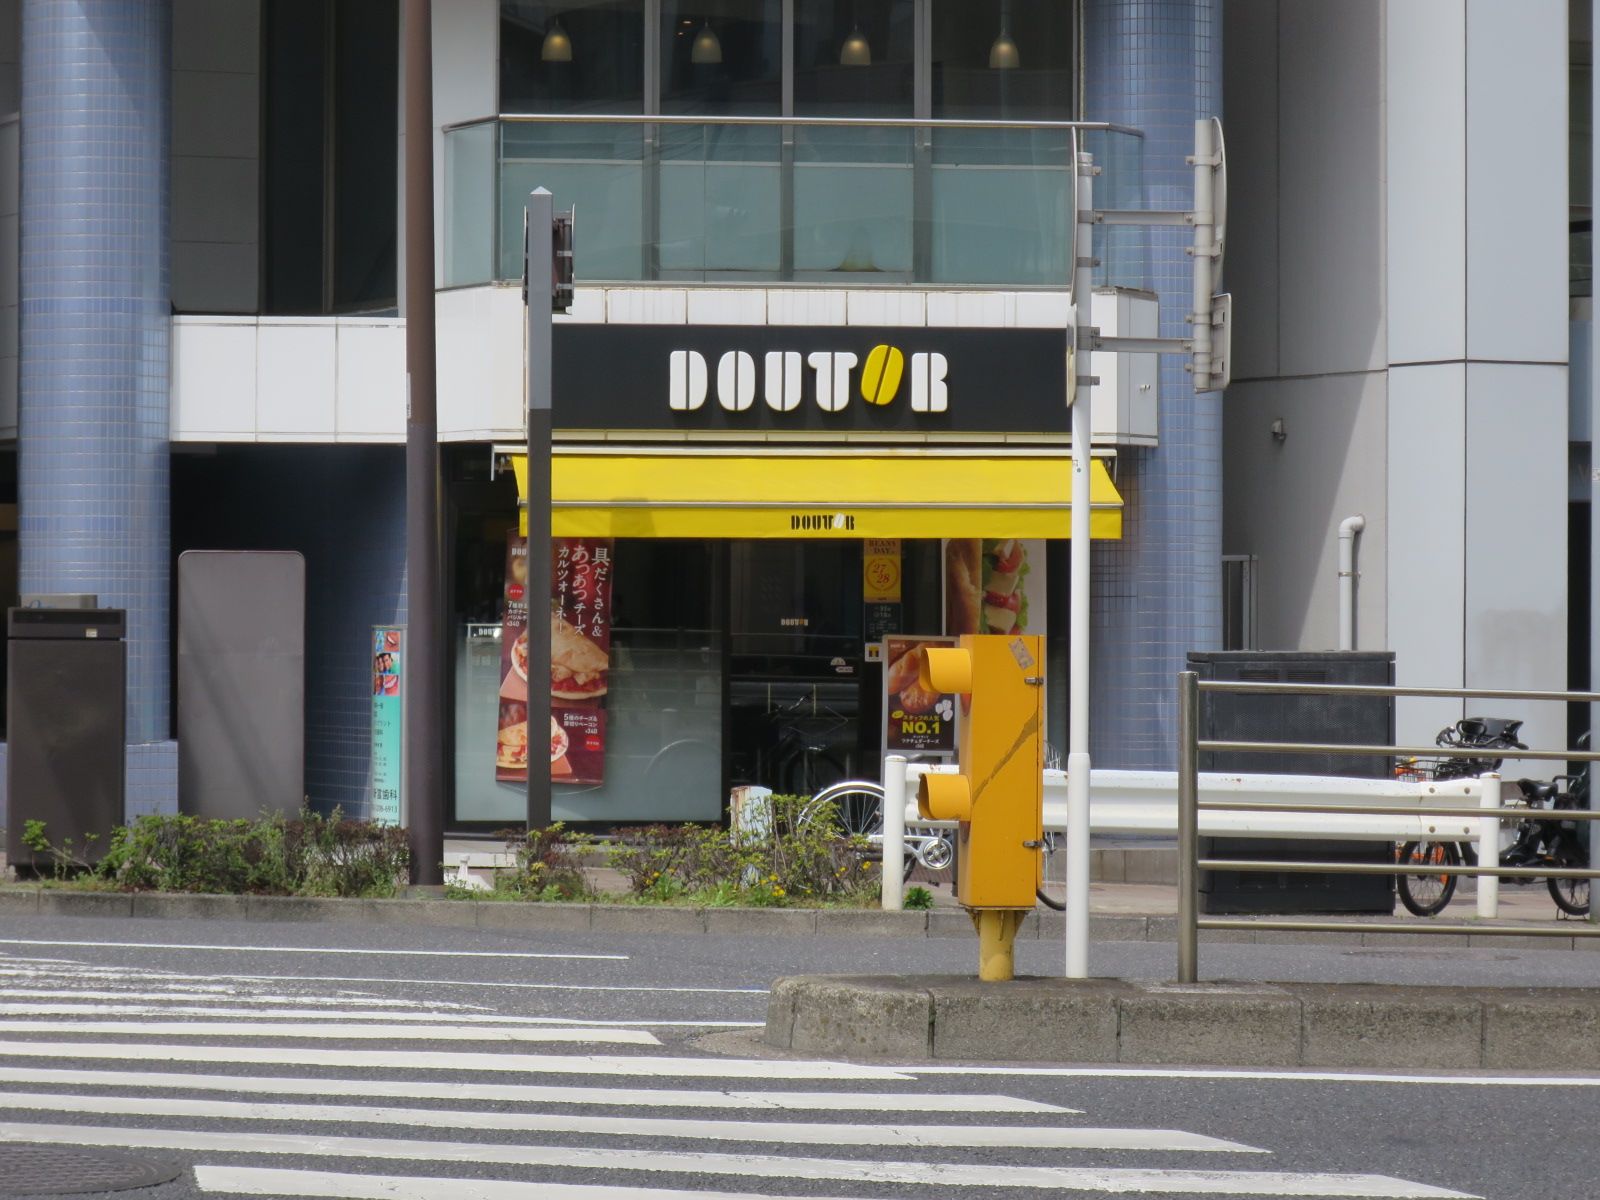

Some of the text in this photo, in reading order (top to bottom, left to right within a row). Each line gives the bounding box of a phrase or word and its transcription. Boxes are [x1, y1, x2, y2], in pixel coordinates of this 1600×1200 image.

[670, 344, 948, 412] DOUTOR
[791, 512, 855, 530] DOUTOR
[571, 544, 590, 635] あつあつチーズ
[591, 547, 610, 637] 具だくさん&
[902, 721, 940, 734] NO.1
